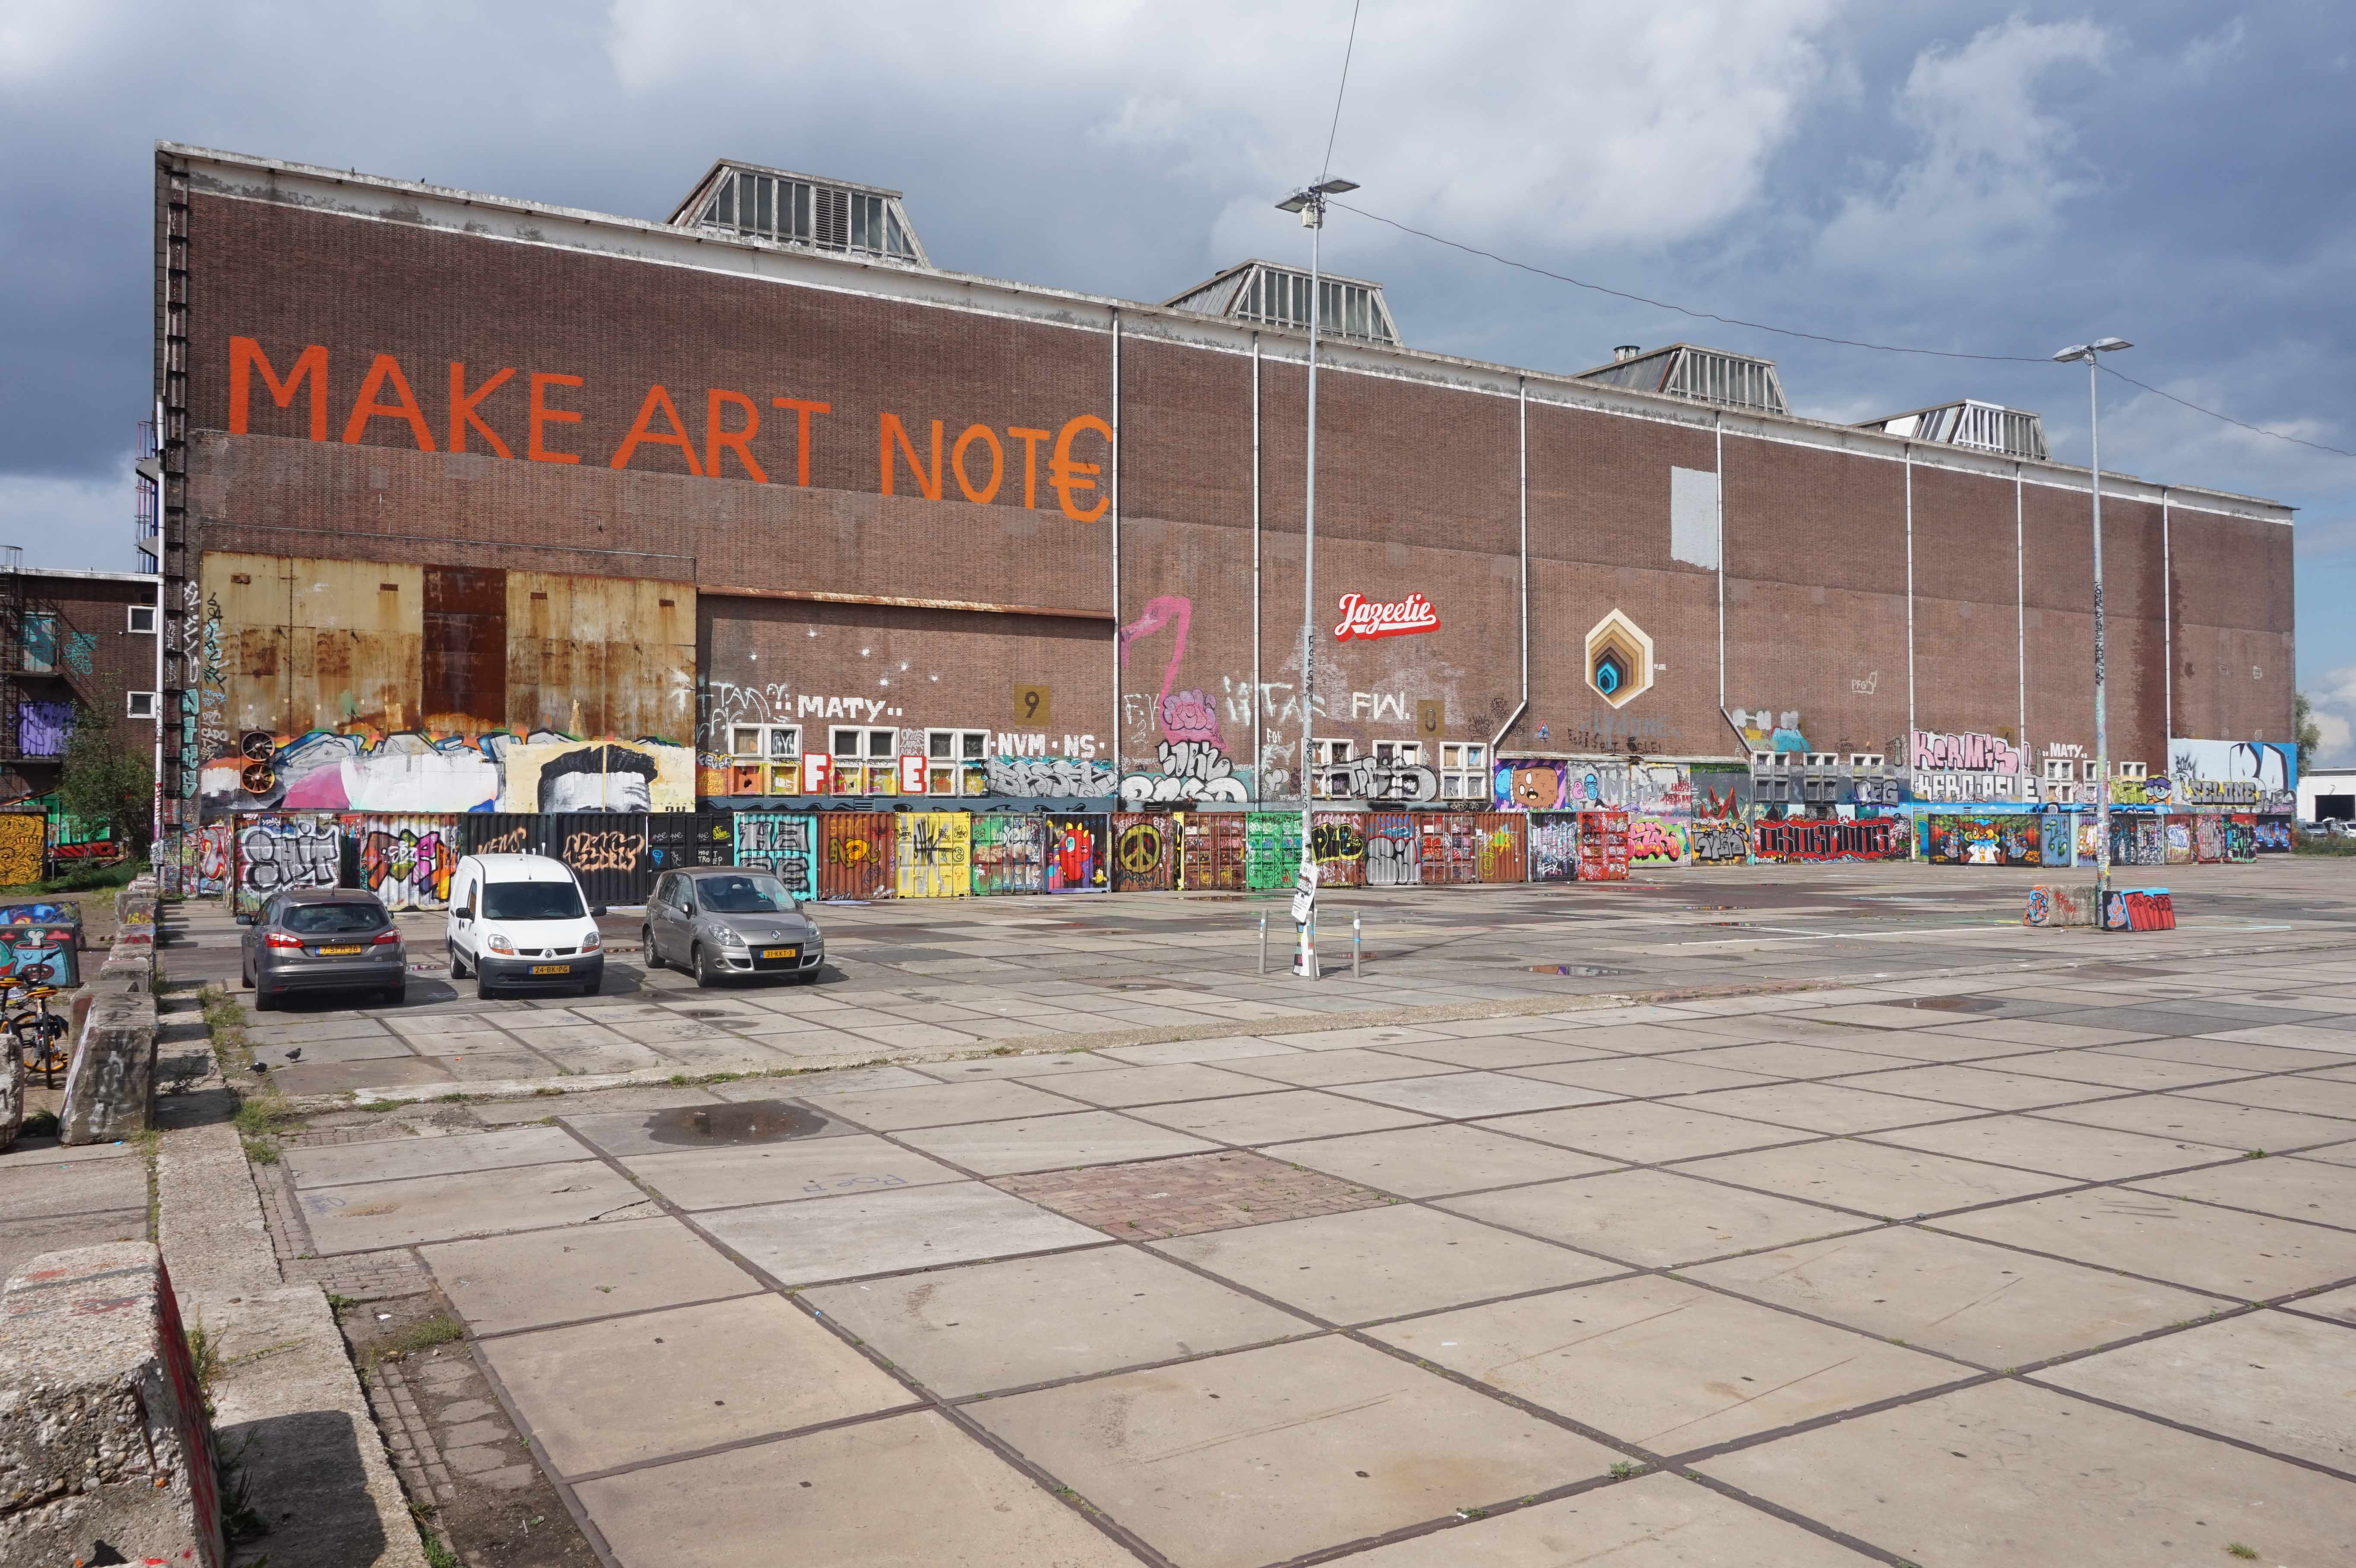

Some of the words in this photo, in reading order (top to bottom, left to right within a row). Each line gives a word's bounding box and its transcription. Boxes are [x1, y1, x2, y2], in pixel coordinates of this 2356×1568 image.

[228, 335, 583, 465] MAKE
[609, 385, 832, 487] ART
[1334, 593, 1437, 636] Jazeetie
[1025, 691, 1039, 718] 9
[998, 733, 1045, 756] NVM
[1064, 734, 1096, 758] NS
[804, 753, 829, 793] F
[902, 756, 925, 792] E
[1115, 868, 1165, 885] MARAWI
[323, 945, 358, 953] 7-SPH-36
